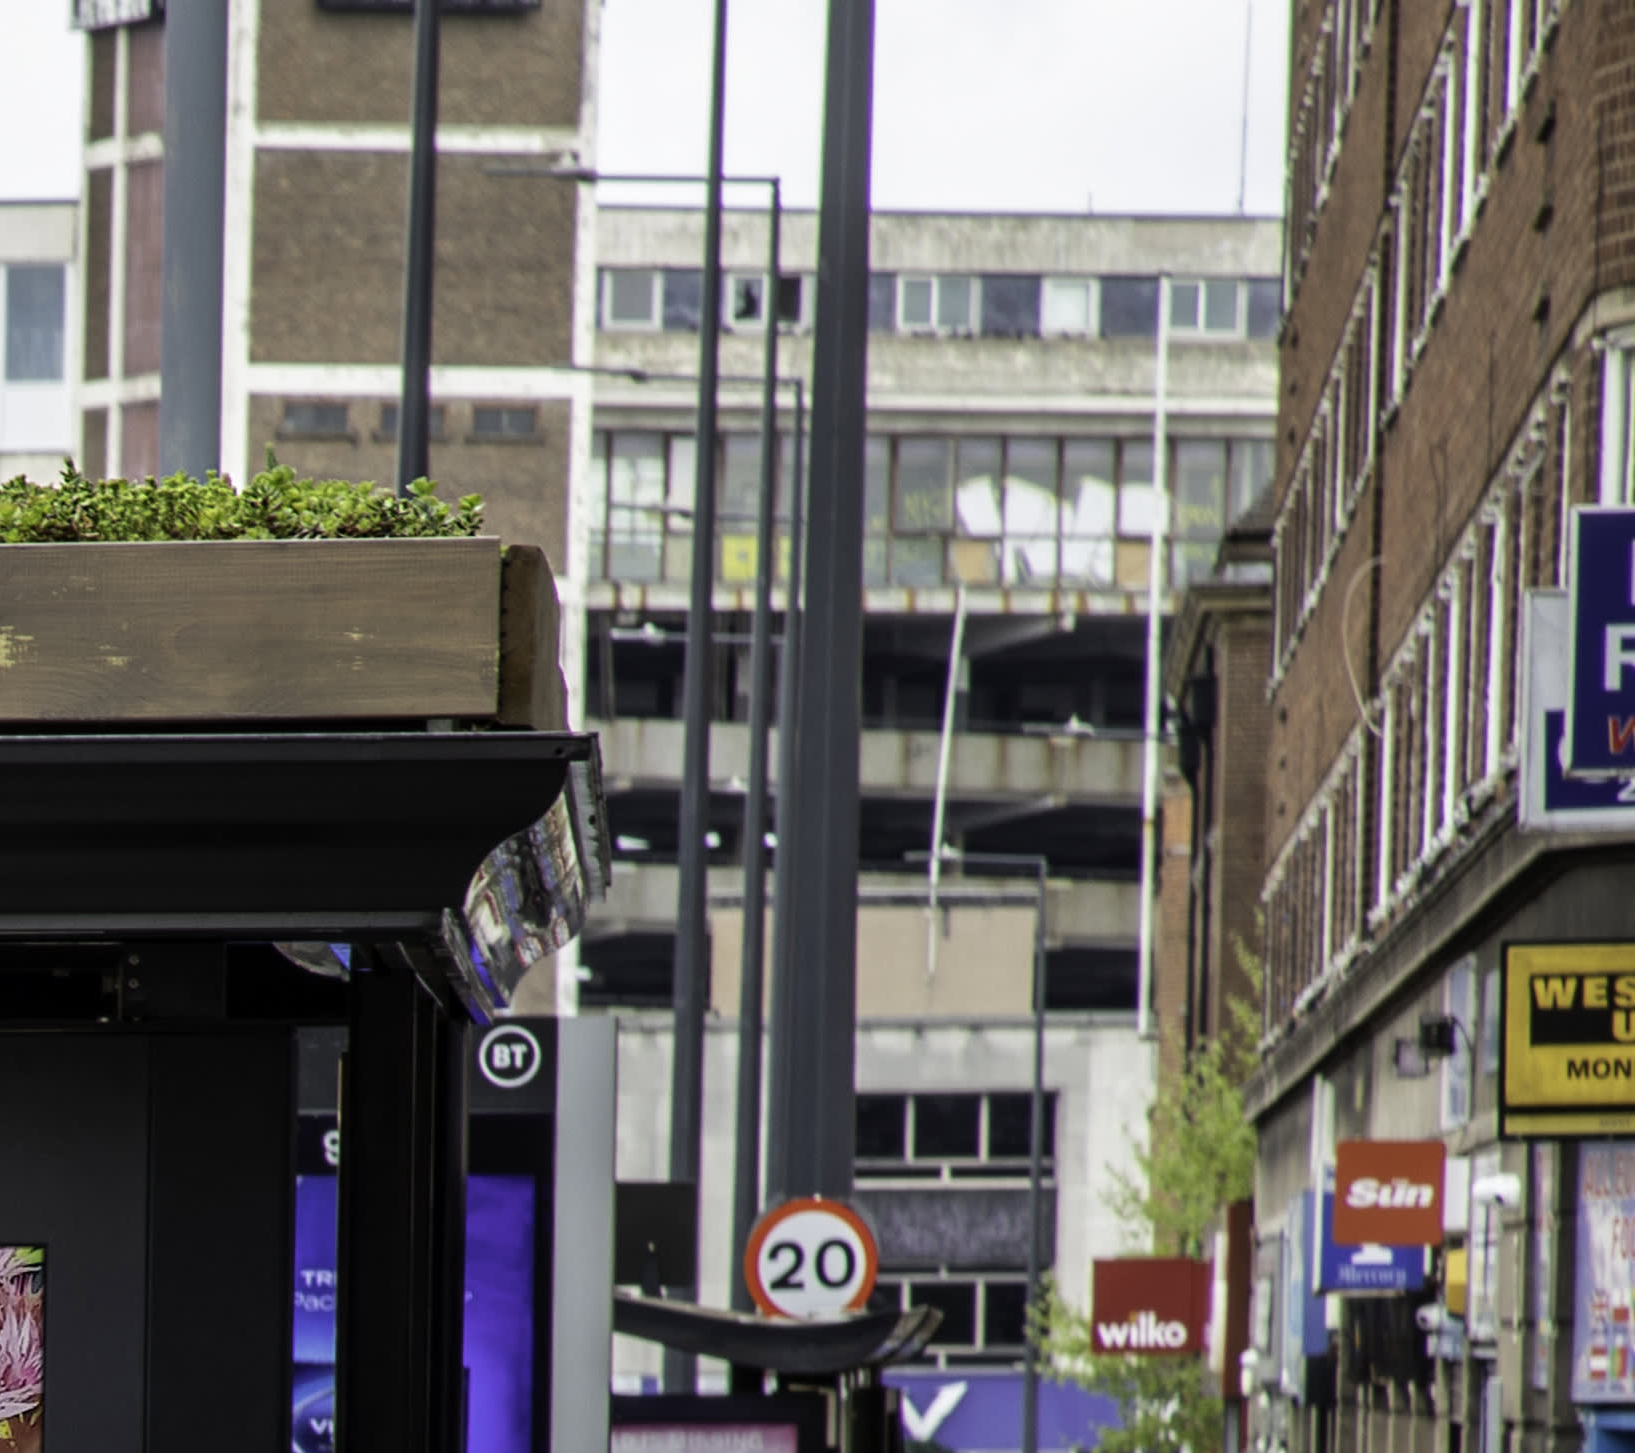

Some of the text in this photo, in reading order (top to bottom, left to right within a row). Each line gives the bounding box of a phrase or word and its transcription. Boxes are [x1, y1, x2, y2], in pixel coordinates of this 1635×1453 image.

[492, 1043, 528, 1069] BT
[1567, 1056, 1635, 1079] MON
[301, 1269, 337, 1287] TR
[767, 1239, 857, 1291] 20
[1097, 1310, 1188, 1348] wilko
